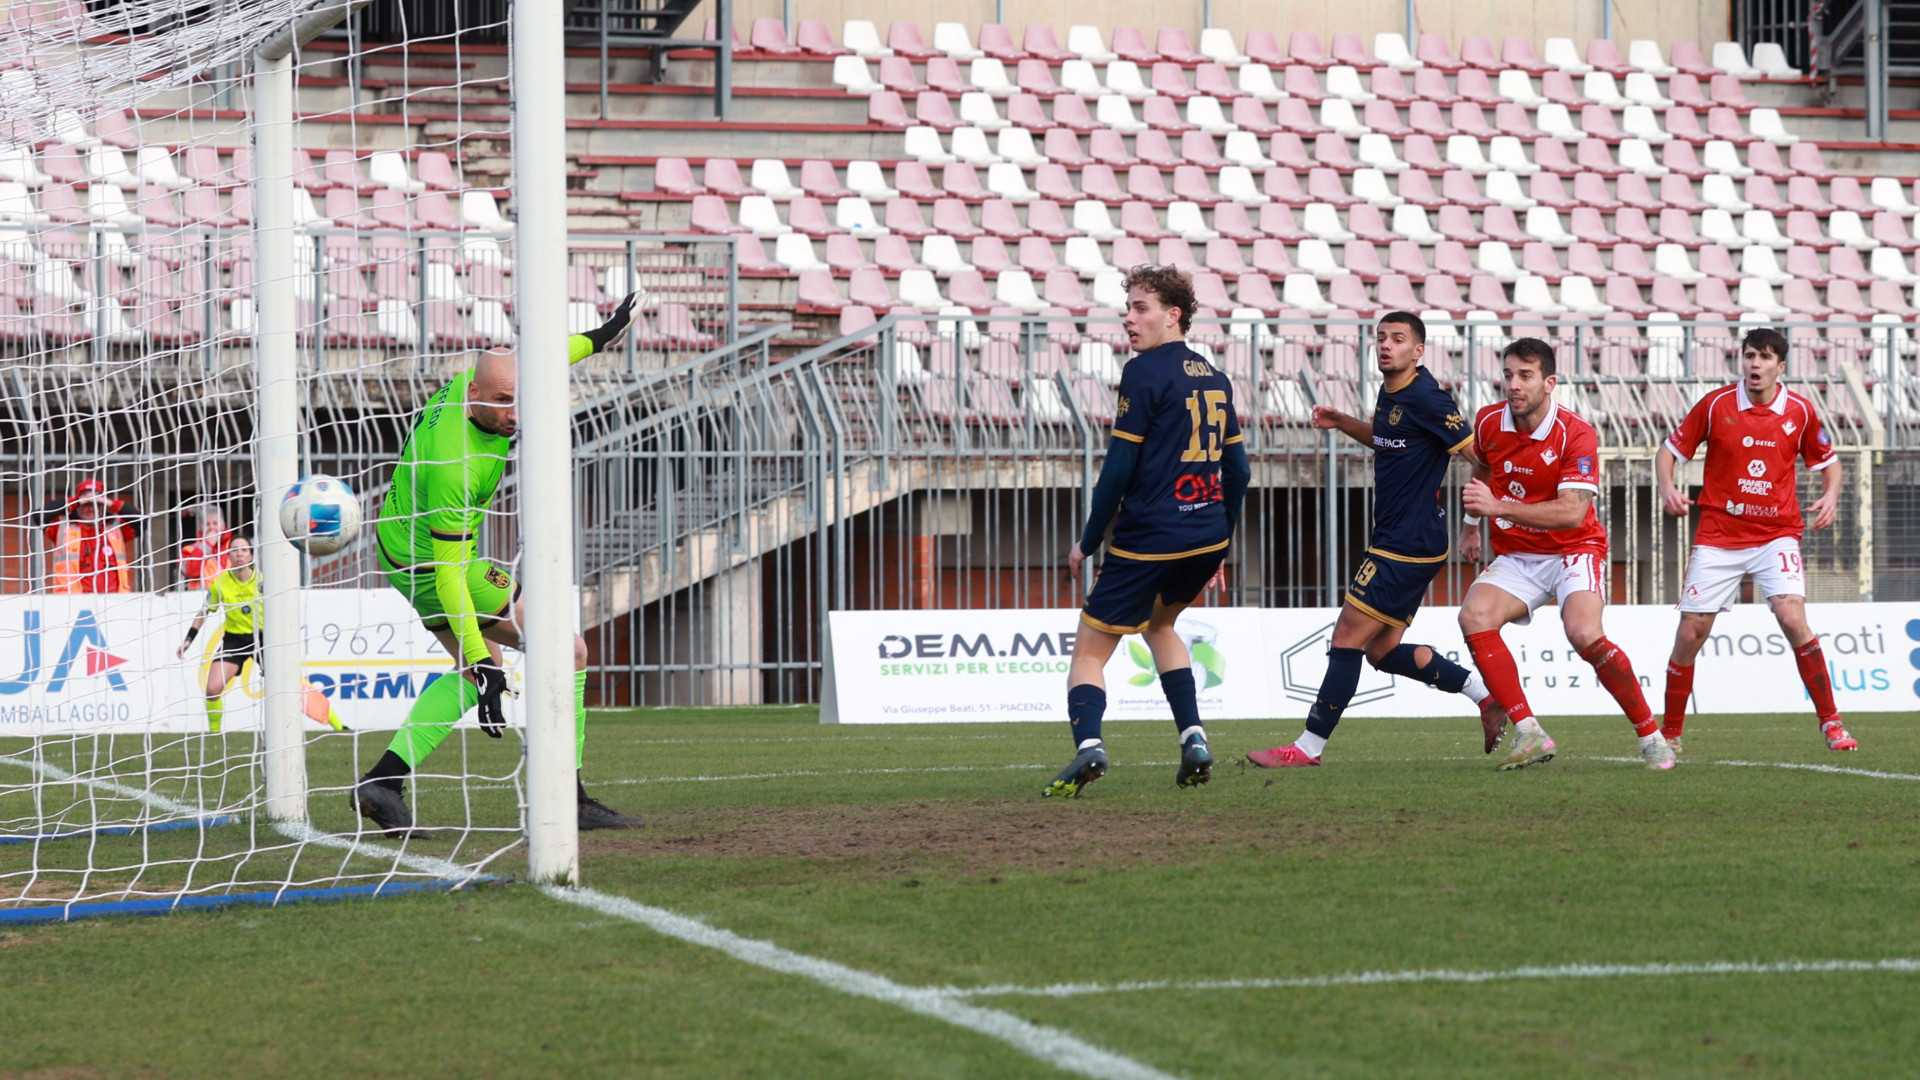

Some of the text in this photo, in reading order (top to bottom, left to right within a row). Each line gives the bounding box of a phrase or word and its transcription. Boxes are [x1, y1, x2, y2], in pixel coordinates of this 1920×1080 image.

[1180, 390, 1227, 462] 15
[1755, 439, 1776, 447] GETEC
[1513, 466, 1534, 475] GETEC
[1738, 478, 1772, 489] PIANETA
[1741, 486, 1769, 496] PADEL
[1778, 551, 1800, 573] 19
[878, 632, 1077, 659] DEM.ME
[1700, 624, 1885, 657] masrati
[880, 661, 1069, 676] SERVIZI PER L'ECOLO
[1804, 660, 1890, 700] lus
[0, 703, 130, 724] MBALLAGGIO
[883, 705, 898, 714] Via
[901, 704, 948, 715] Giuseppe
[979, 703, 992, 712] 51
[1000, 702, 1052, 712] PIACENZA
